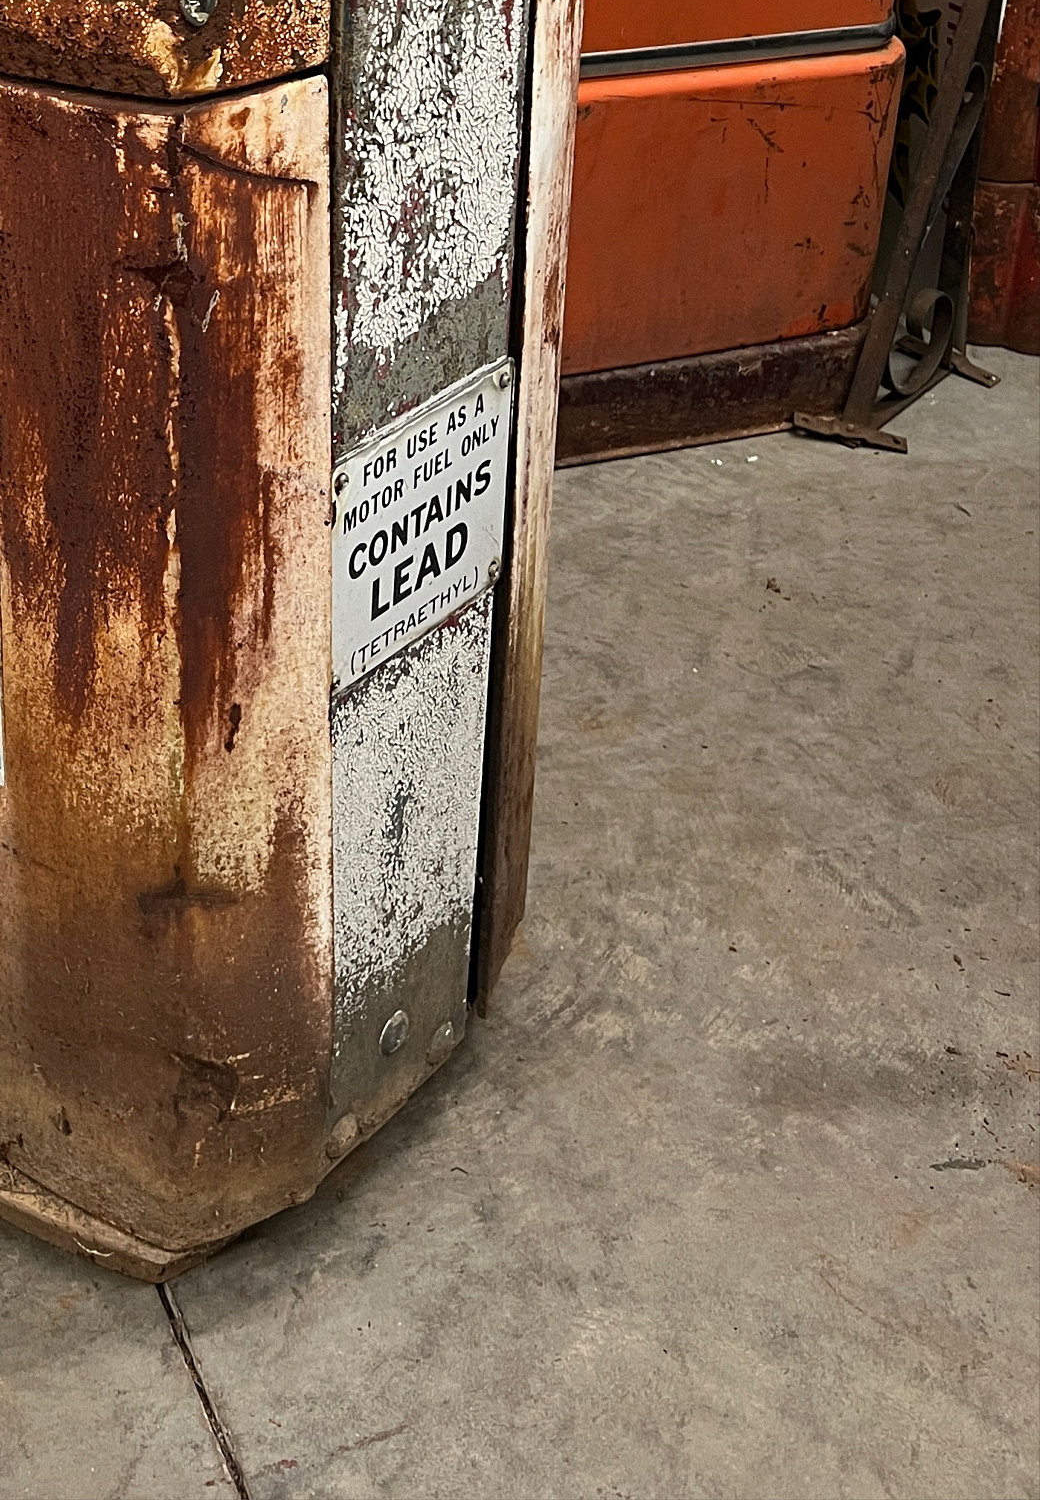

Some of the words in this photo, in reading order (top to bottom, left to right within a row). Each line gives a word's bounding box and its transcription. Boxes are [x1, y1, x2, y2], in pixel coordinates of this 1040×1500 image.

[342, 477, 405, 536] MOTOR
[413, 448, 454, 490] FUEL
[460, 414, 501, 458] ONLY
[362, 447, 398, 487] FOR
[406, 421, 439, 460] USE
[445, 404, 468, 436] AS
[474, 392, 485, 418] A
[348, 458, 493, 581] CONTAINS
[370, 520, 469, 623] LEAD
[349, 565, 480, 677] (TETRAETHYL)
